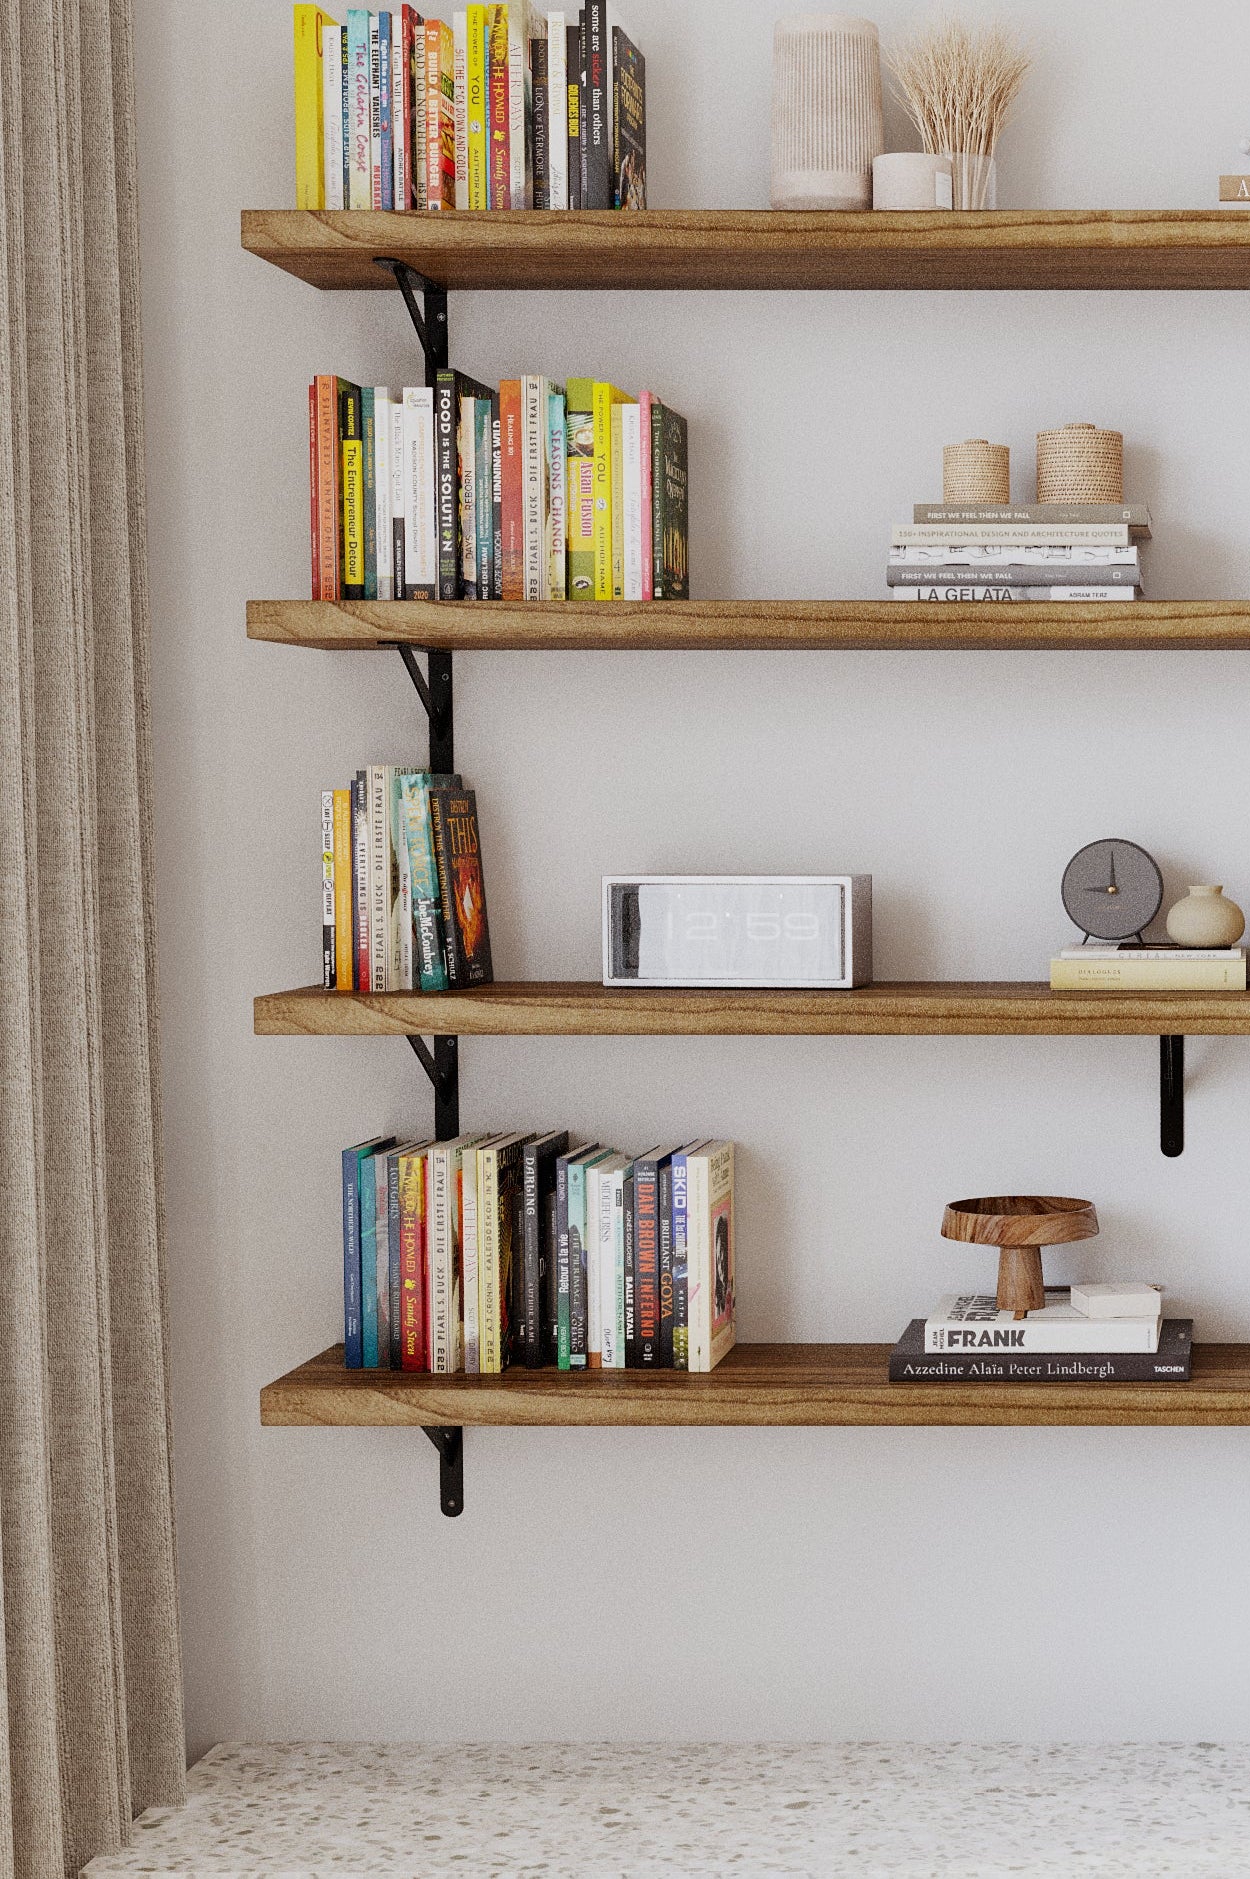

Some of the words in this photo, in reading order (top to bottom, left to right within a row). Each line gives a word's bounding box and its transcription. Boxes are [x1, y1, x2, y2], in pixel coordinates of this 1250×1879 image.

[591, 5, 601, 32] some
[356, 43, 367, 66] The
[416, 34, 425, 69] ROAD
[455, 49, 465, 62] SIT
[592, 35, 600, 51] are
[417, 77, 425, 92] TO
[428, 52, 438, 85] BUILD
[456, 65, 465, 80] THE
[592, 53, 602, 86] sicker
[356, 74, 368, 127] Gelatin
[428, 87, 438, 97] A
[568, 84, 579, 118] GOLDENES
[592, 88, 602, 111] than
[372, 96, 380, 138] VANISHES
[417, 98, 426, 163] NOWHERE
[428, 99, 439, 140] BETTER
[456, 108, 465, 132] DOWN
[569, 119, 579, 137] BUCH
[593, 114, 603, 145] others
[357, 135, 368, 172] Coast
[456, 135, 465, 152] AND
[429, 142, 439, 187] BURGER
[456, 155, 466, 182] COLOR
[418, 182, 425, 195] HS
[440, 389, 451, 433] FOOD
[529, 398, 537, 425] FRAU
[322, 397, 331, 465] CERVANTES
[442, 438, 450, 447] IS
[493, 420, 501, 445] WILD
[529, 430, 537, 459] ERSTE
[347, 447, 356, 467] The
[551, 430, 562, 489] SEASONS
[493, 449, 501, 502] RUNNING
[529, 465, 537, 482] DIE
[580, 461, 593, 494] Asian
[345, 470, 359, 538] Entrepreneur
[529, 496, 537, 523] BUCK
[581, 498, 594, 537] Fusion
[552, 496, 563, 556] CHANGE
[348, 541, 358, 578] Detour
[465, 535, 473, 559] DAYS
[529, 539, 538, 571] PEARL
[413, 591, 428, 599] 2020
[917, 588, 939, 601] LA
[945, 588, 1013, 601] GELATA
[404, 786, 424, 833] SPENT
[431, 798, 440, 832] DESTROY
[447, 817, 478, 854] THIS
[437, 856, 447, 888] MARTIN
[359, 902, 366, 911] IS
[440, 891, 450, 921] LUTHER
[526, 1157, 535, 1215] DARLING
[638, 1184, 654, 1214] DAN
[673, 1166, 686, 1208] SKID
[403, 1217, 415, 1229] HE
[464, 1199, 475, 1243] AFTER
[403, 1233, 415, 1273] HOWLED
[639, 1220, 654, 1273] BROWN
[661, 1219, 670, 1270] BRILLIANT
[465, 1247, 475, 1284] DAYS
[404, 1296, 416, 1327] Sandy
[640, 1278, 654, 1337] INFERNO
[661, 1273, 673, 1318] GOYA
[626, 1307, 634, 1340] FATALE
[947, 1329, 1026, 1347] FRANK
[406, 1331, 416, 1355] Steen
[903, 1363, 964, 1375] Azzedine
[969, 1363, 1003, 1375] Alaïa
[1009, 1363, 1041, 1375] Peter
[1046, 1363, 1115, 1377] Lindbergh
